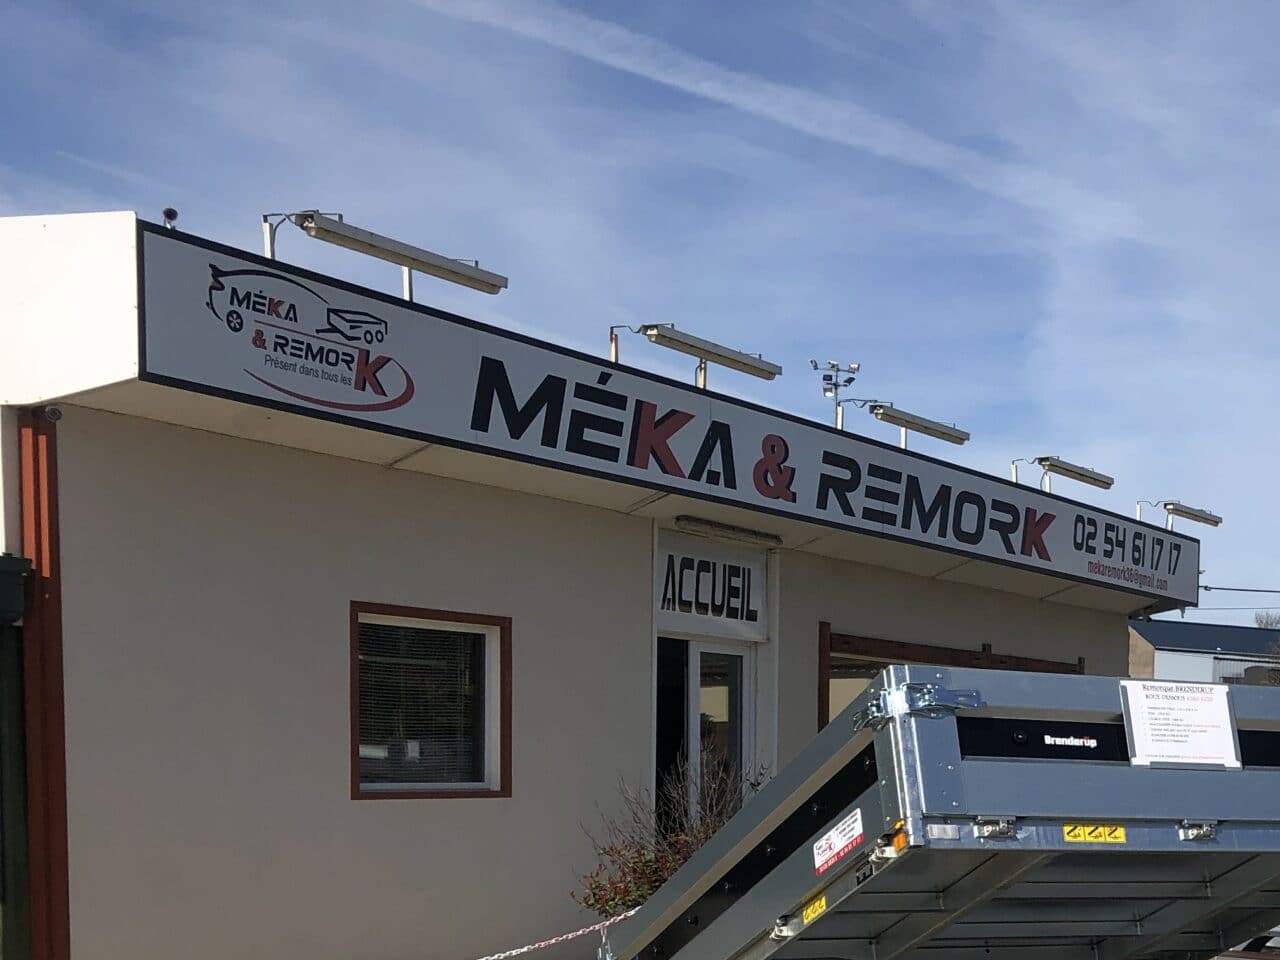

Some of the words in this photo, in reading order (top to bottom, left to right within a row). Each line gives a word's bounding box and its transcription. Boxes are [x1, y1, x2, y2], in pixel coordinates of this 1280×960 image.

[229, 286, 299, 323] MÉKA
[252, 329, 267, 350] &
[273, 334, 393, 397] REMORK
[264, 354, 298, 374] Présent
[299, 364, 320, 379] dans
[321, 367, 339, 382] tous
[340, 371, 352, 386] les
[470, 355, 738, 490] MÉKA
[752, 434, 797, 504] &
[816, 450, 1057, 562] REMORK
[1073, 514, 1097, 555] 02
[1103, 522, 1126, 562] 54
[1131, 531, 1147, 568] 61
[1151, 536, 1164, 571] 17
[1168, 541, 1181, 576] 17
[660, 553, 758, 622] ACCUEIL
